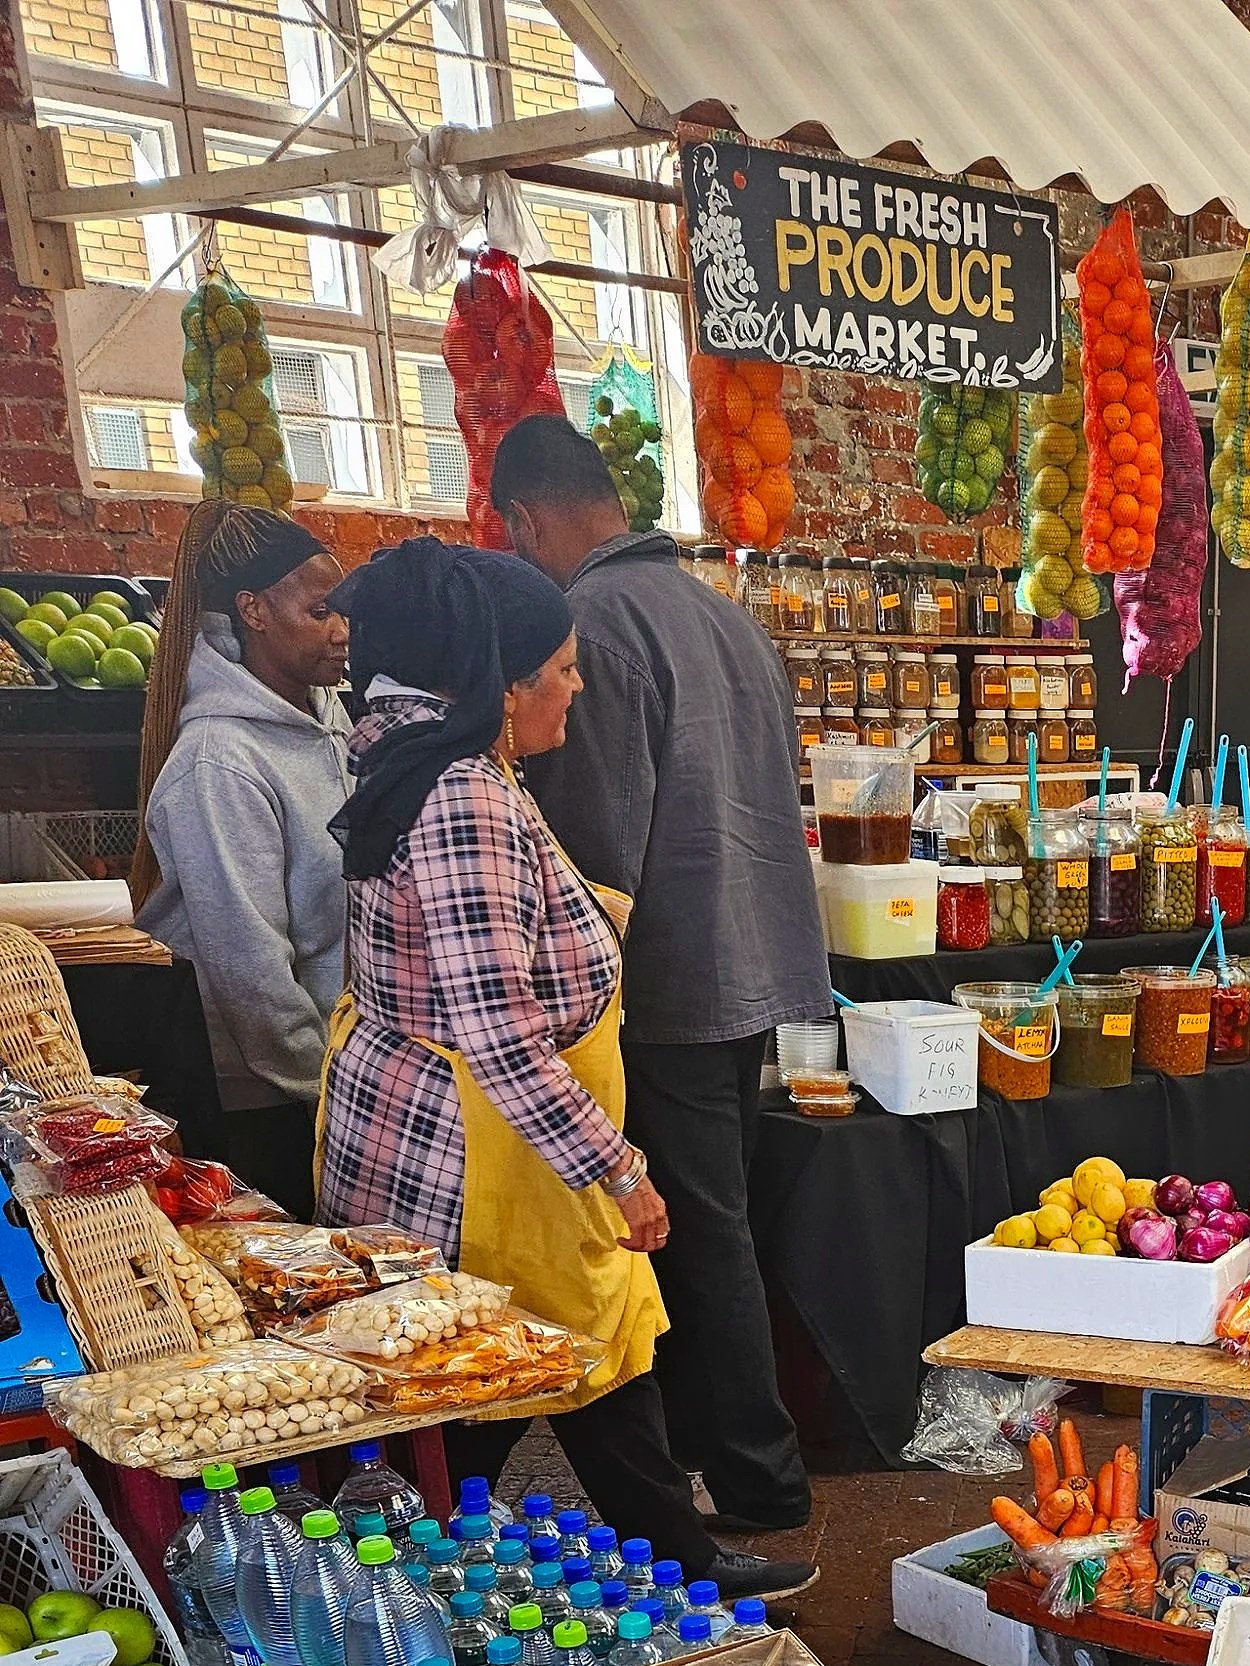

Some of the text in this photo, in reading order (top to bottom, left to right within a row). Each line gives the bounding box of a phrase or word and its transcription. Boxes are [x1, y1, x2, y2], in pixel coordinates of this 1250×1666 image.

[778, 167, 987, 249] THE FRESH
[775, 218, 1015, 323] PRODUCE
[793, 303, 986, 370] MARKET.
[918, 1033, 966, 1055] SOUR
[927, 1062, 956, 1080] FIG
[1164, 1530, 1210, 1546] Kalahari
